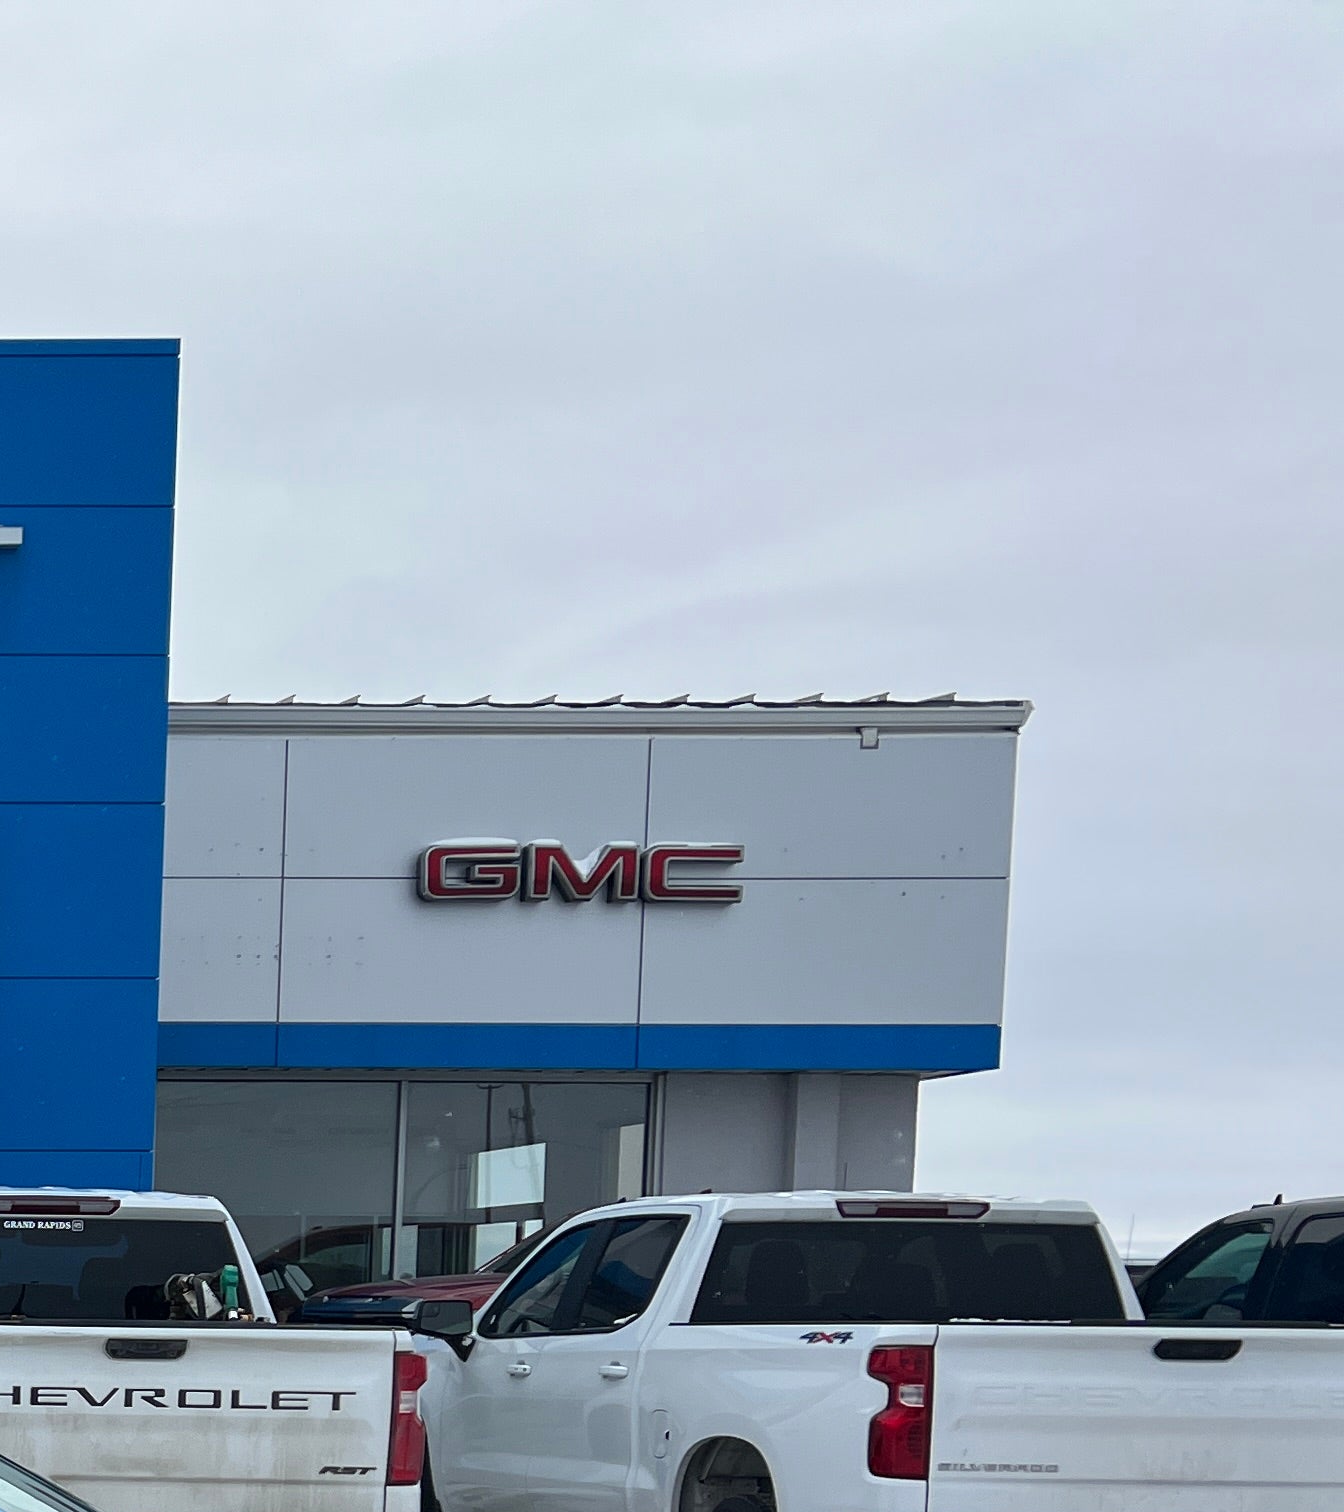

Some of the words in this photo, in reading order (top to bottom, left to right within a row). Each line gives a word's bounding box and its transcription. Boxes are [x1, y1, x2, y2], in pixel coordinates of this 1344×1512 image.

[416, 837, 746, 904] GMC
[3, 1221, 36, 1229] GRAND
[37, 1221, 72, 1230] RAPIDS
[318, 1465, 378, 1476] RST
[937, 1462, 1059, 1473] SILVERADO
